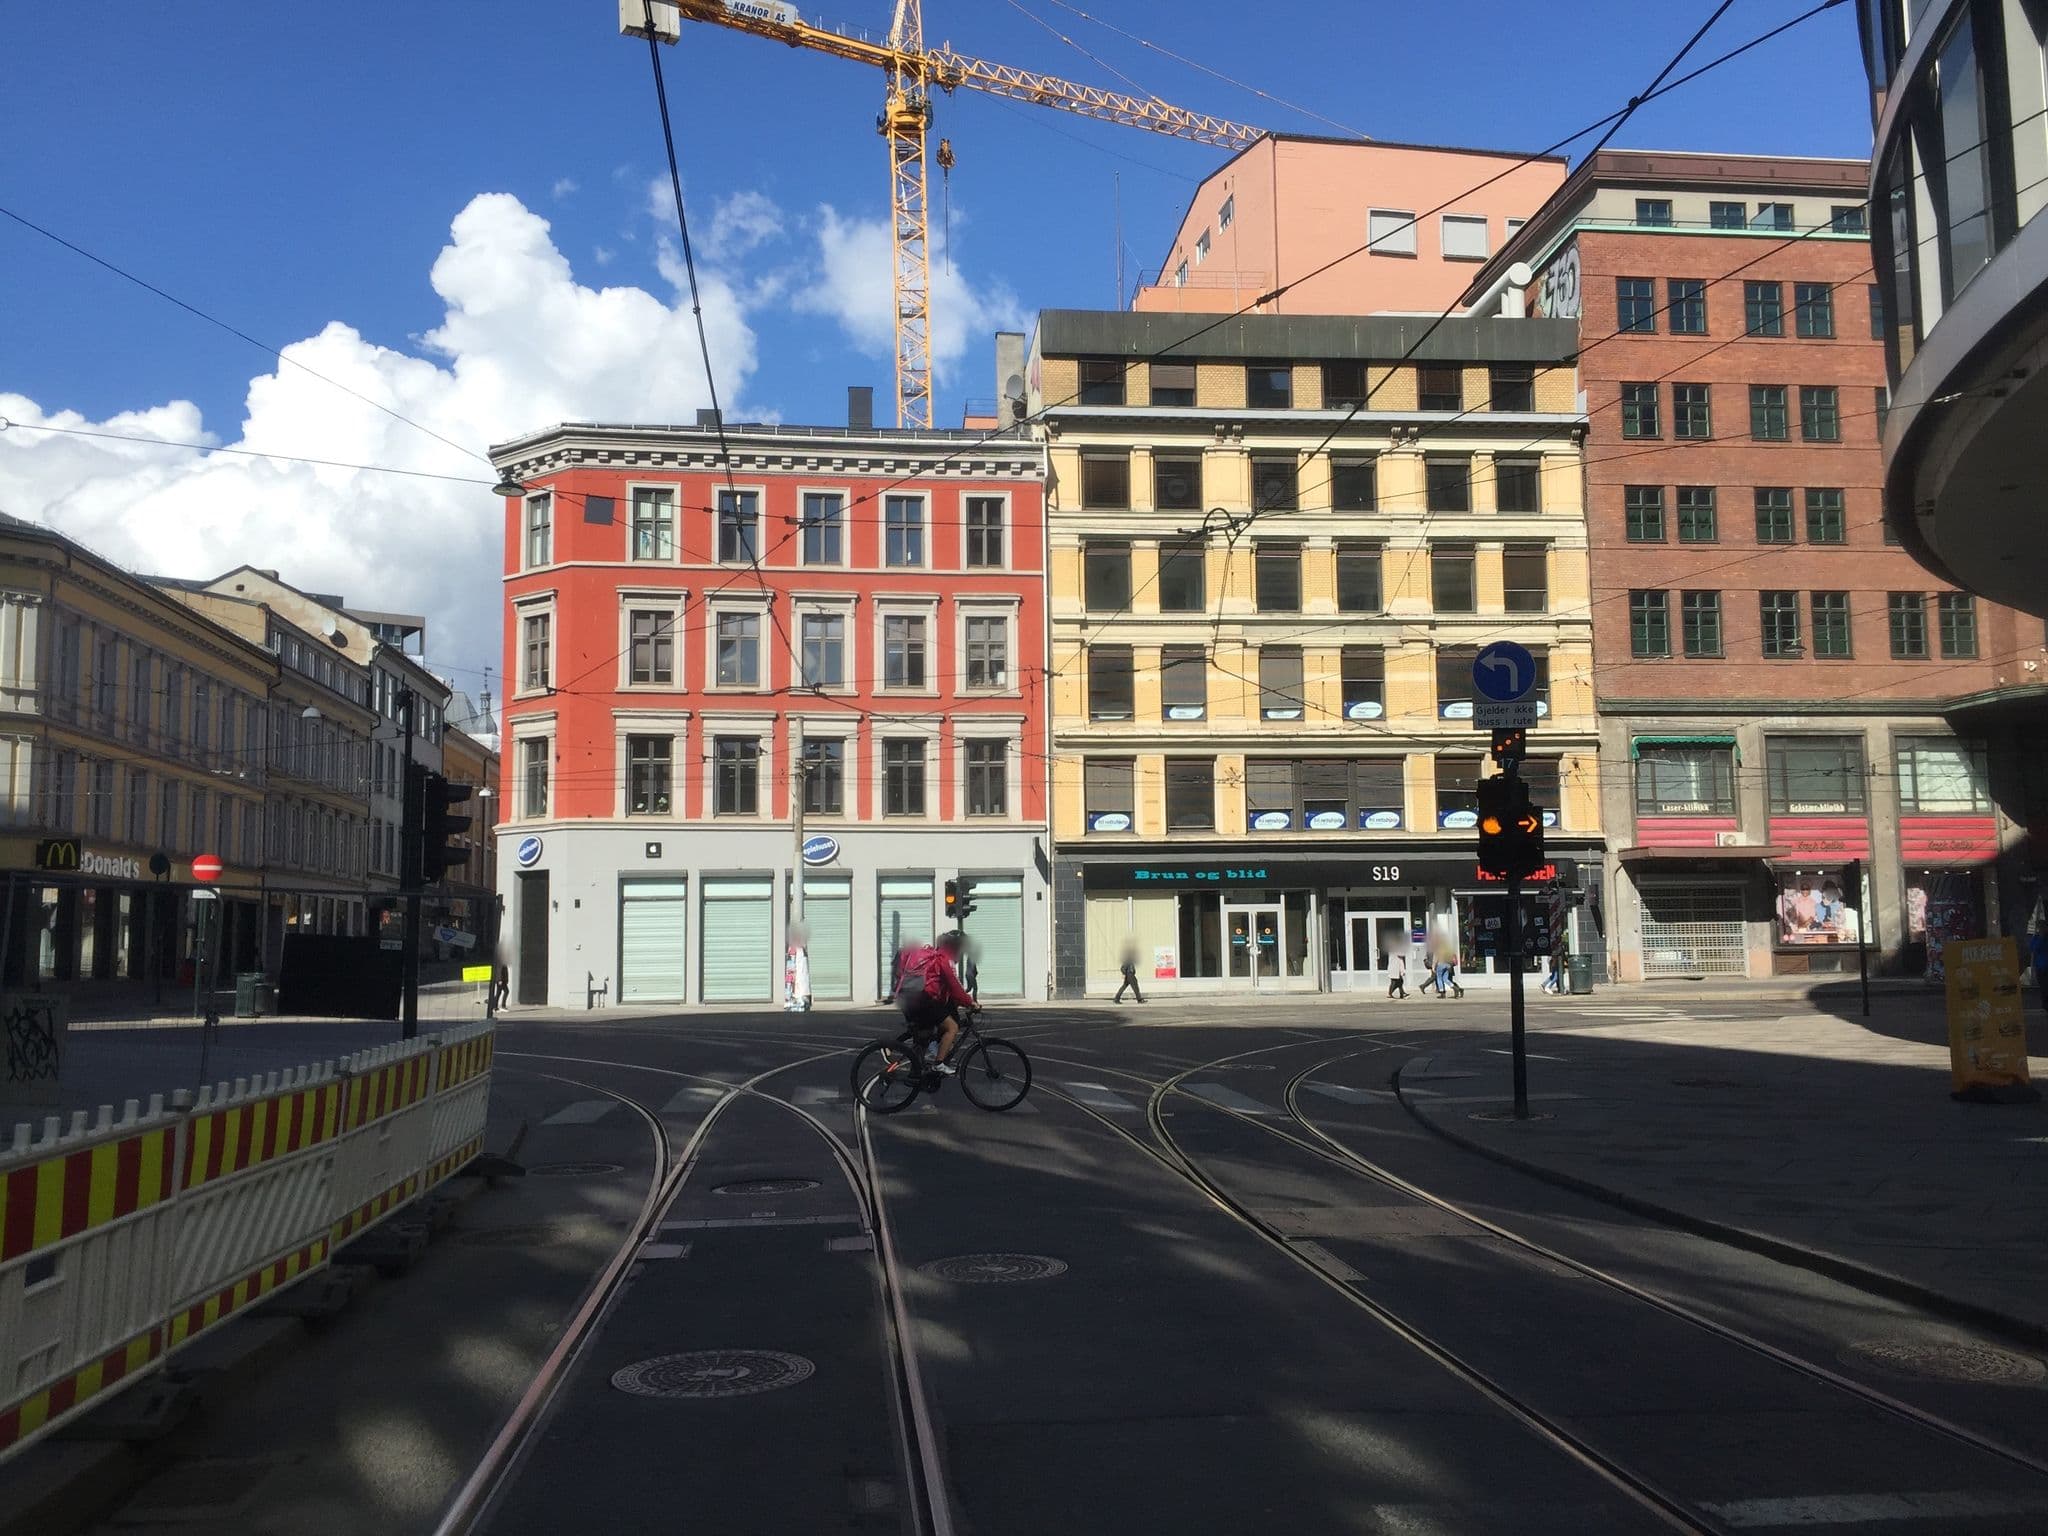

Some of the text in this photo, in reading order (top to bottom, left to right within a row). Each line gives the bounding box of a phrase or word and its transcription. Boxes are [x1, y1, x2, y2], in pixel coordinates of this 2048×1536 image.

[734, 1, 786, 22] KRANOR AS
[1476, 705, 1509, 715] Gjelder
[1514, 705, 1534, 713] ikke
[1478, 718, 1500, 726] buss
[1513, 717, 1533, 725] rute
[1500, 758, 1514, 769] 17
[1135, 869, 1267, 881] Brun og blid
[1372, 866, 1400, 881] S19
